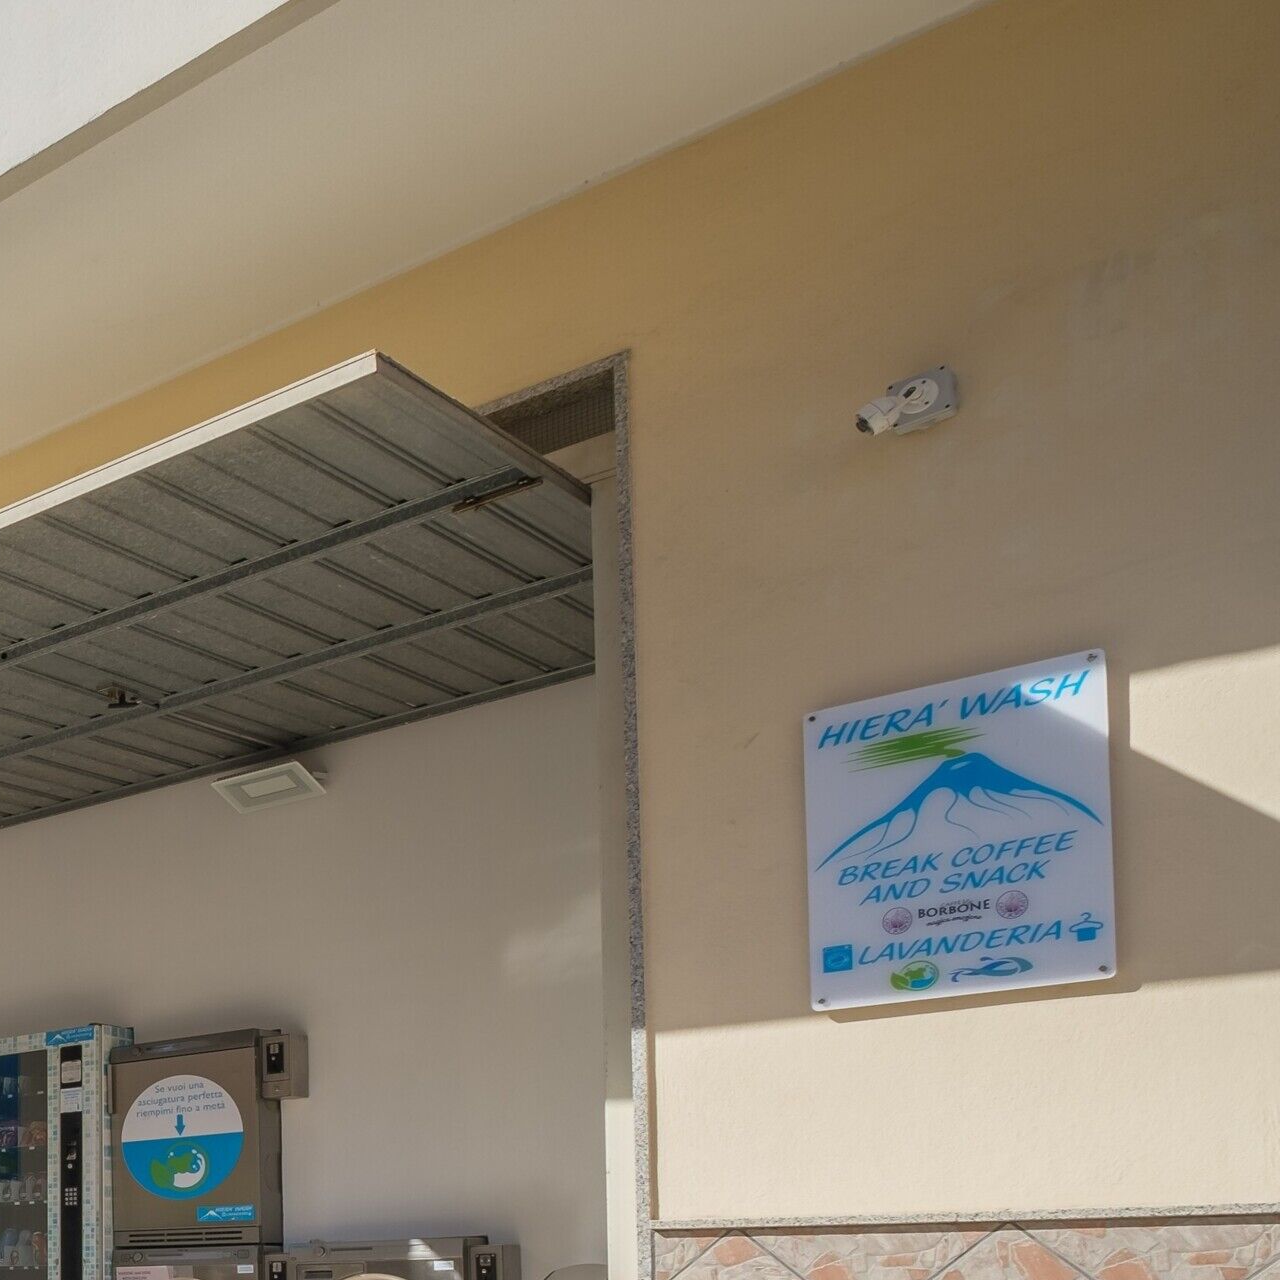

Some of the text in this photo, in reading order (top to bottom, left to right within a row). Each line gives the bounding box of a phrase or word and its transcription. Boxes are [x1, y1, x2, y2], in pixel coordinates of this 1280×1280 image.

[960, 669, 1090, 720] WASH
[837, 829, 1078, 886] BREAK COFFEE
[859, 860, 1050, 906] AND SNACK
[918, 898, 990, 919] BORBONE
[858, 920, 1061, 965] LAVANDERIA
[137, 1090, 223, 1107] asciugatura perfetta
[154, 1081, 204, 1094] Se vuoi una
[136, 1107, 174, 1118] riempimi
[176, 1105, 193, 1114] fino
